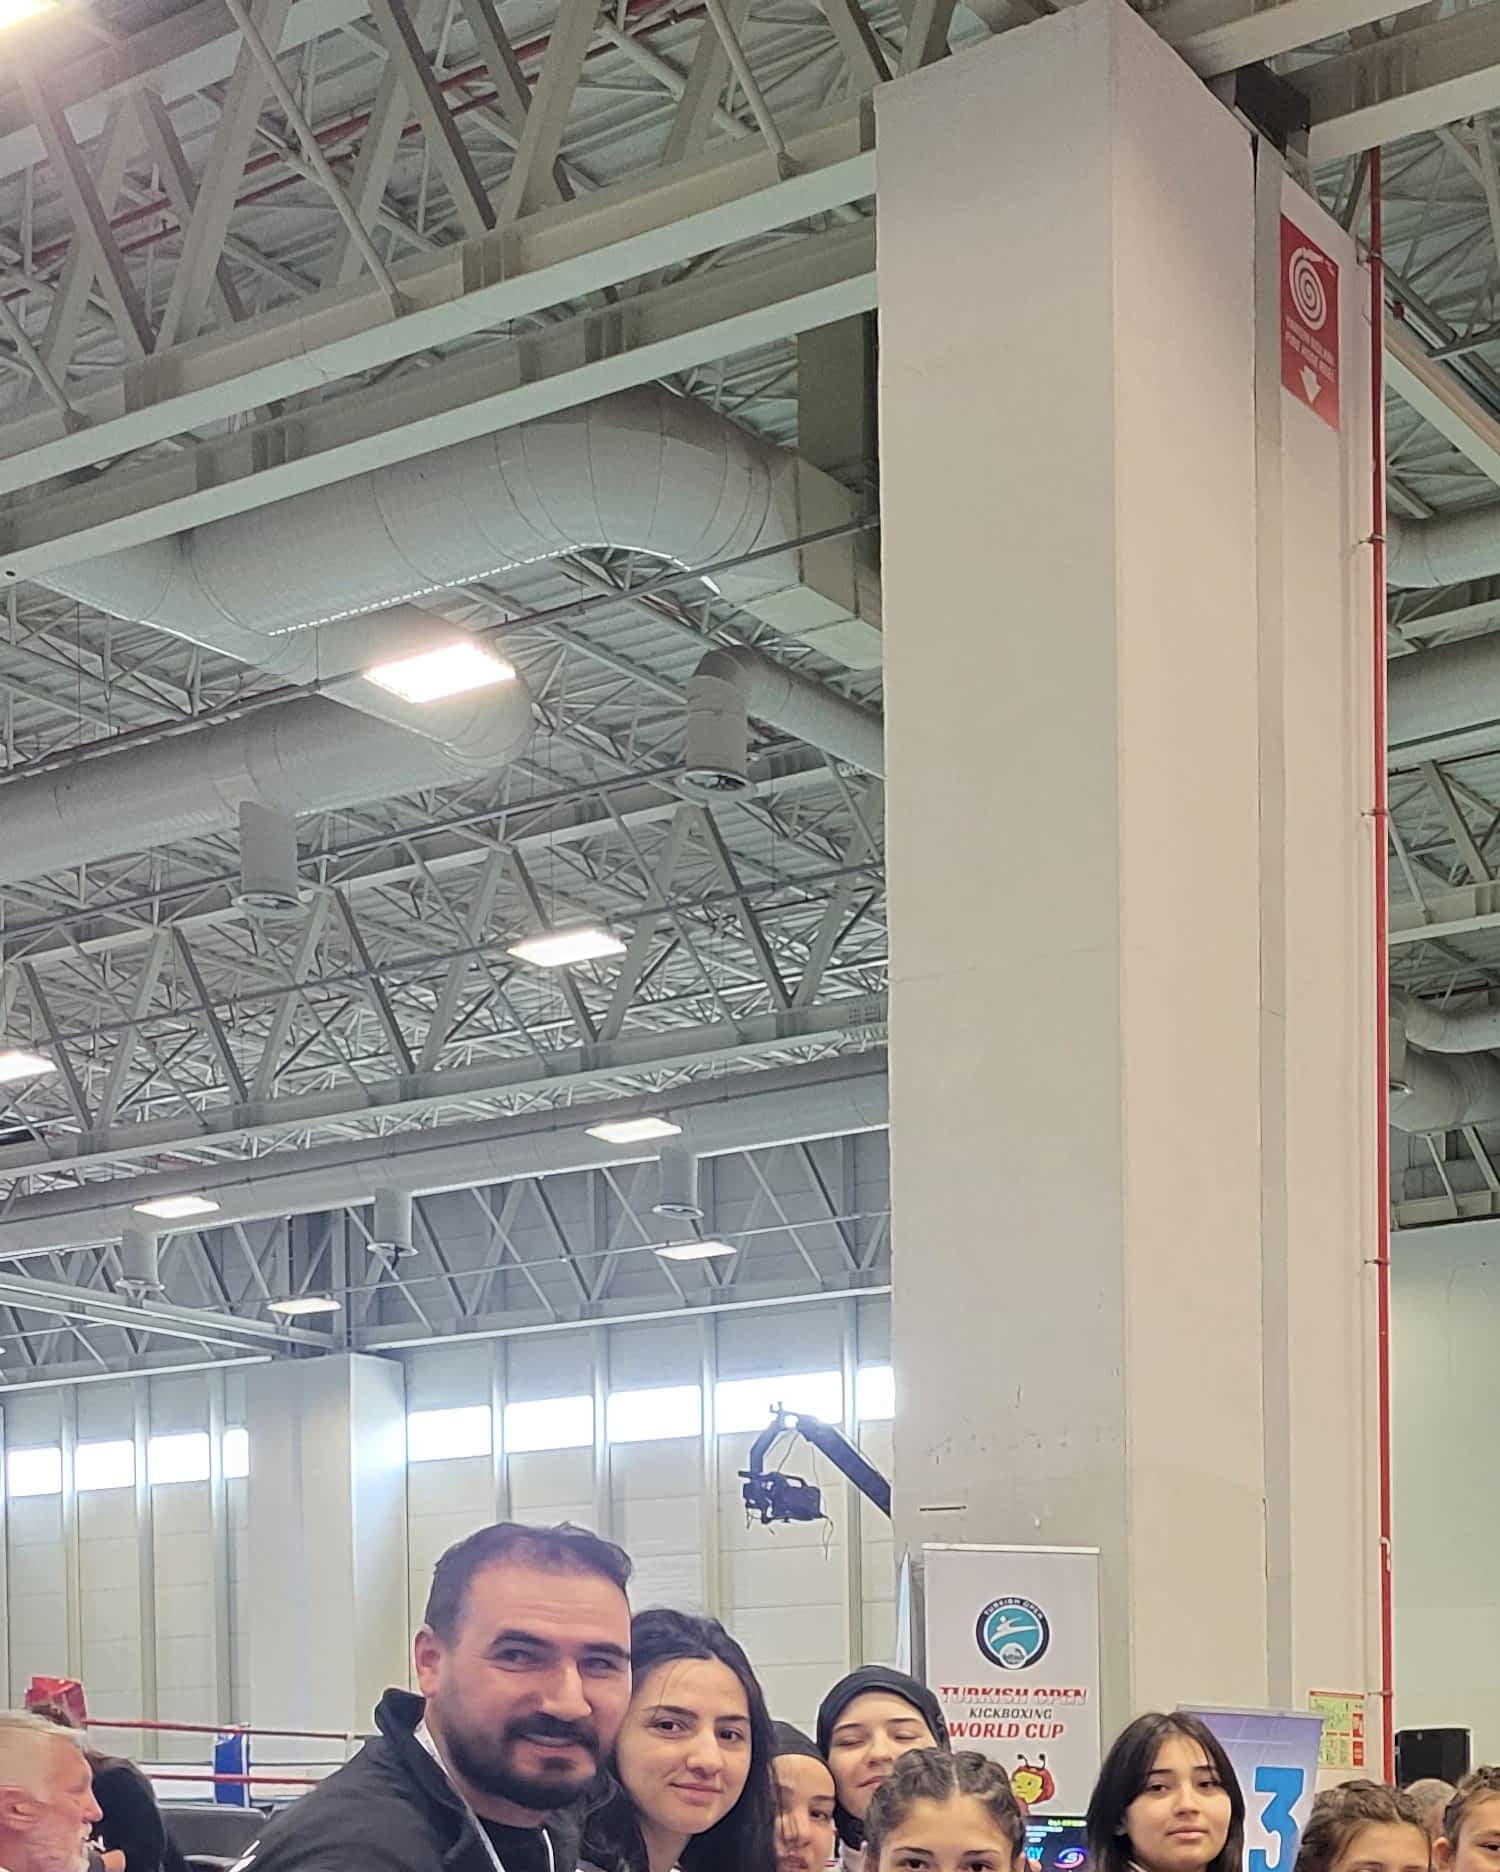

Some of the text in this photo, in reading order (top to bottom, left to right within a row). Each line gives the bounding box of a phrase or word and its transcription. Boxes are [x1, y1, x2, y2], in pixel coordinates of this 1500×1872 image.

[969, 1708, 1052, 1720] KICKBOXING
[950, 1722, 1064, 1738] WORLD CUP
